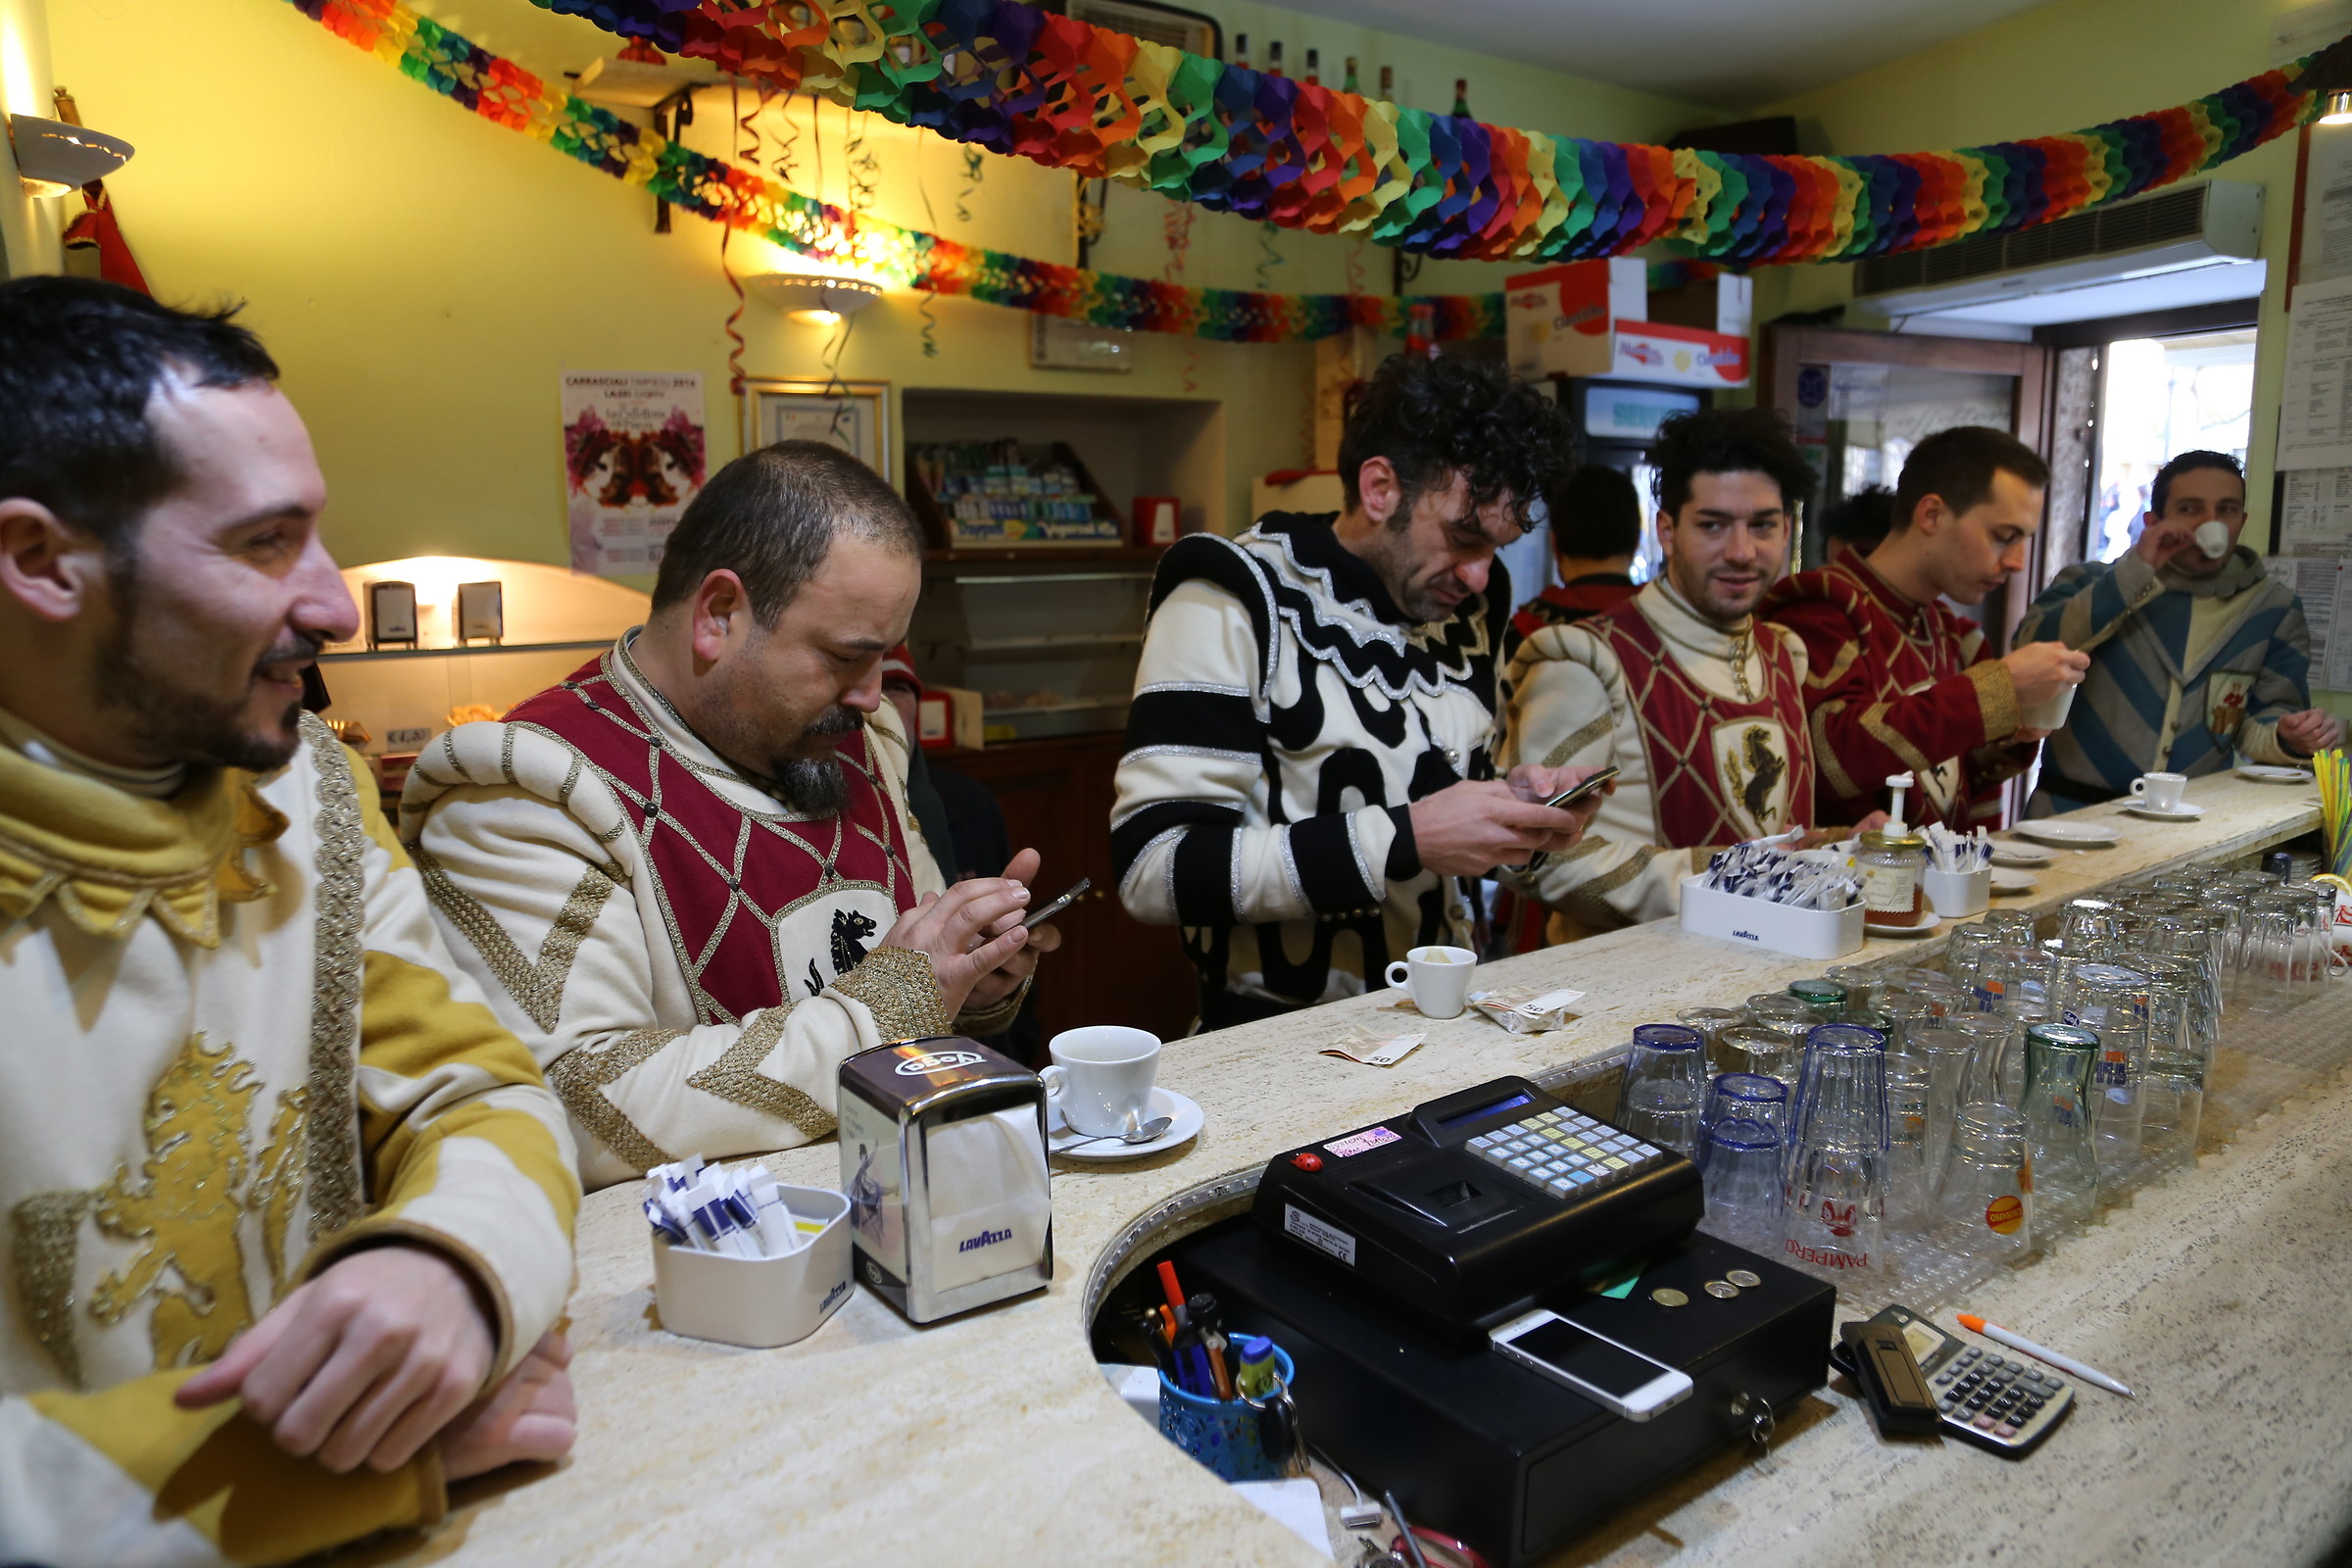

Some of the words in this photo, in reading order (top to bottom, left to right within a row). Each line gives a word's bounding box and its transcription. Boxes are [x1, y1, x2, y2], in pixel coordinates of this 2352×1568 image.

[1523, 1003, 1544, 1014] 50
[1372, 1055, 1392, 1064] 50
[958, 1228, 1012, 1253] LAVAZZA
[1786, 1239, 1868, 1270] PAMPERO
[819, 1280, 847, 1314] LAVAZZA
